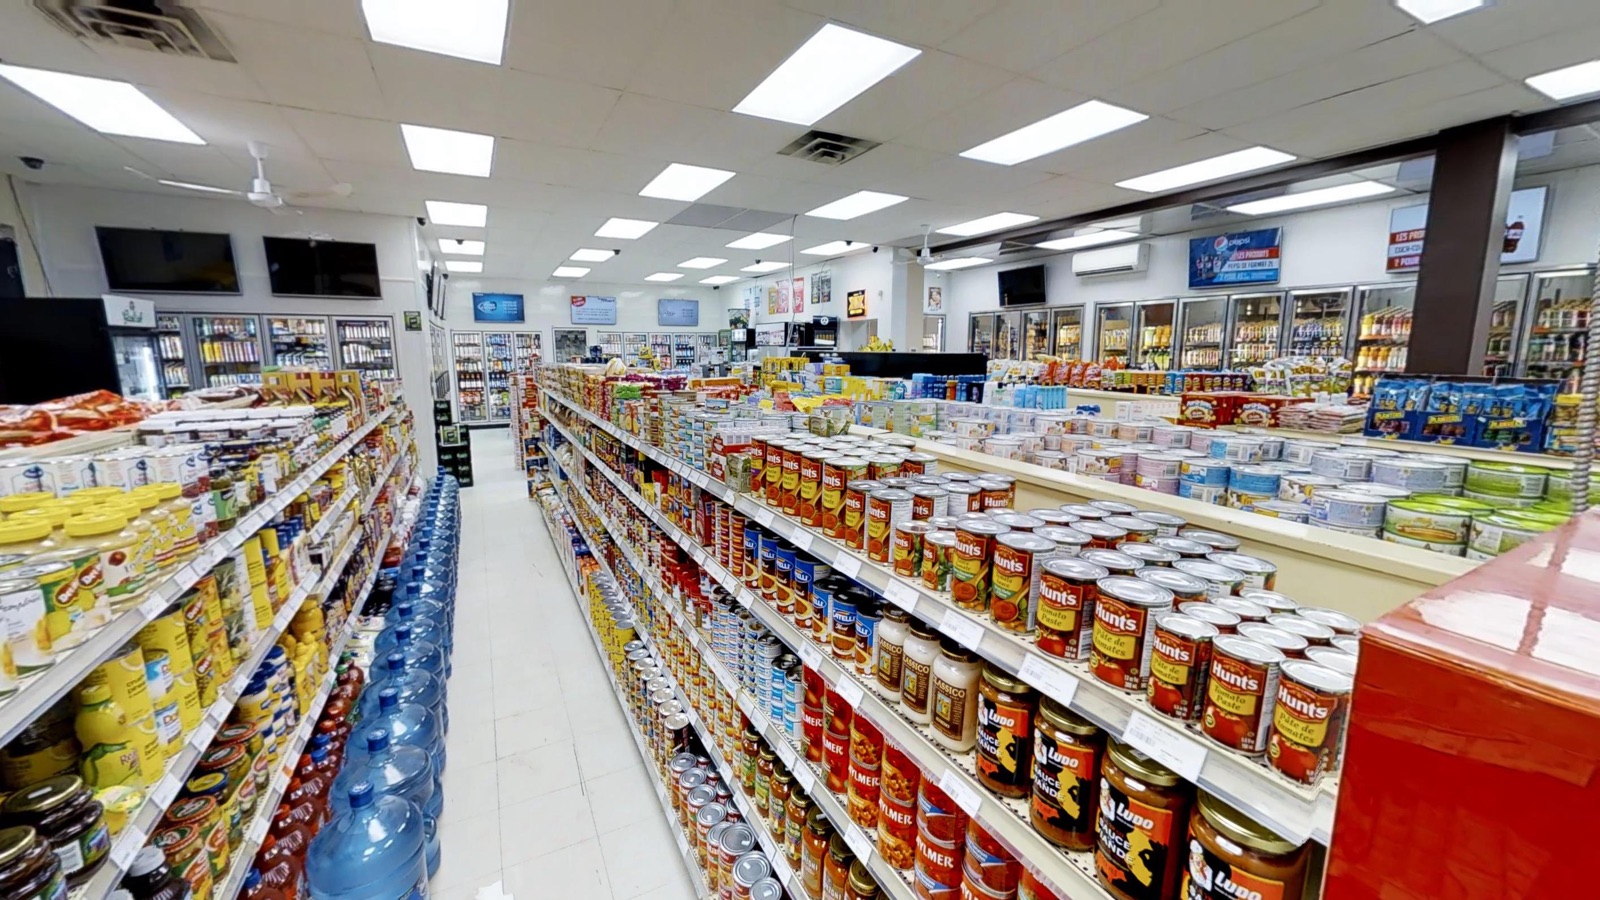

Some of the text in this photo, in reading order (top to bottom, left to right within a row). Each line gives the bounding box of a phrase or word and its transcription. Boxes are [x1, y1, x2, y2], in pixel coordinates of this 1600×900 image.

[1114, 638, 1125, 647] de
[1169, 664, 1180, 675] de
[1214, 685, 1246, 704] Tomato
[1216, 694, 1241, 711] Paste
[1277, 720, 1314, 743] tomates
[1301, 724, 1314, 734] de
